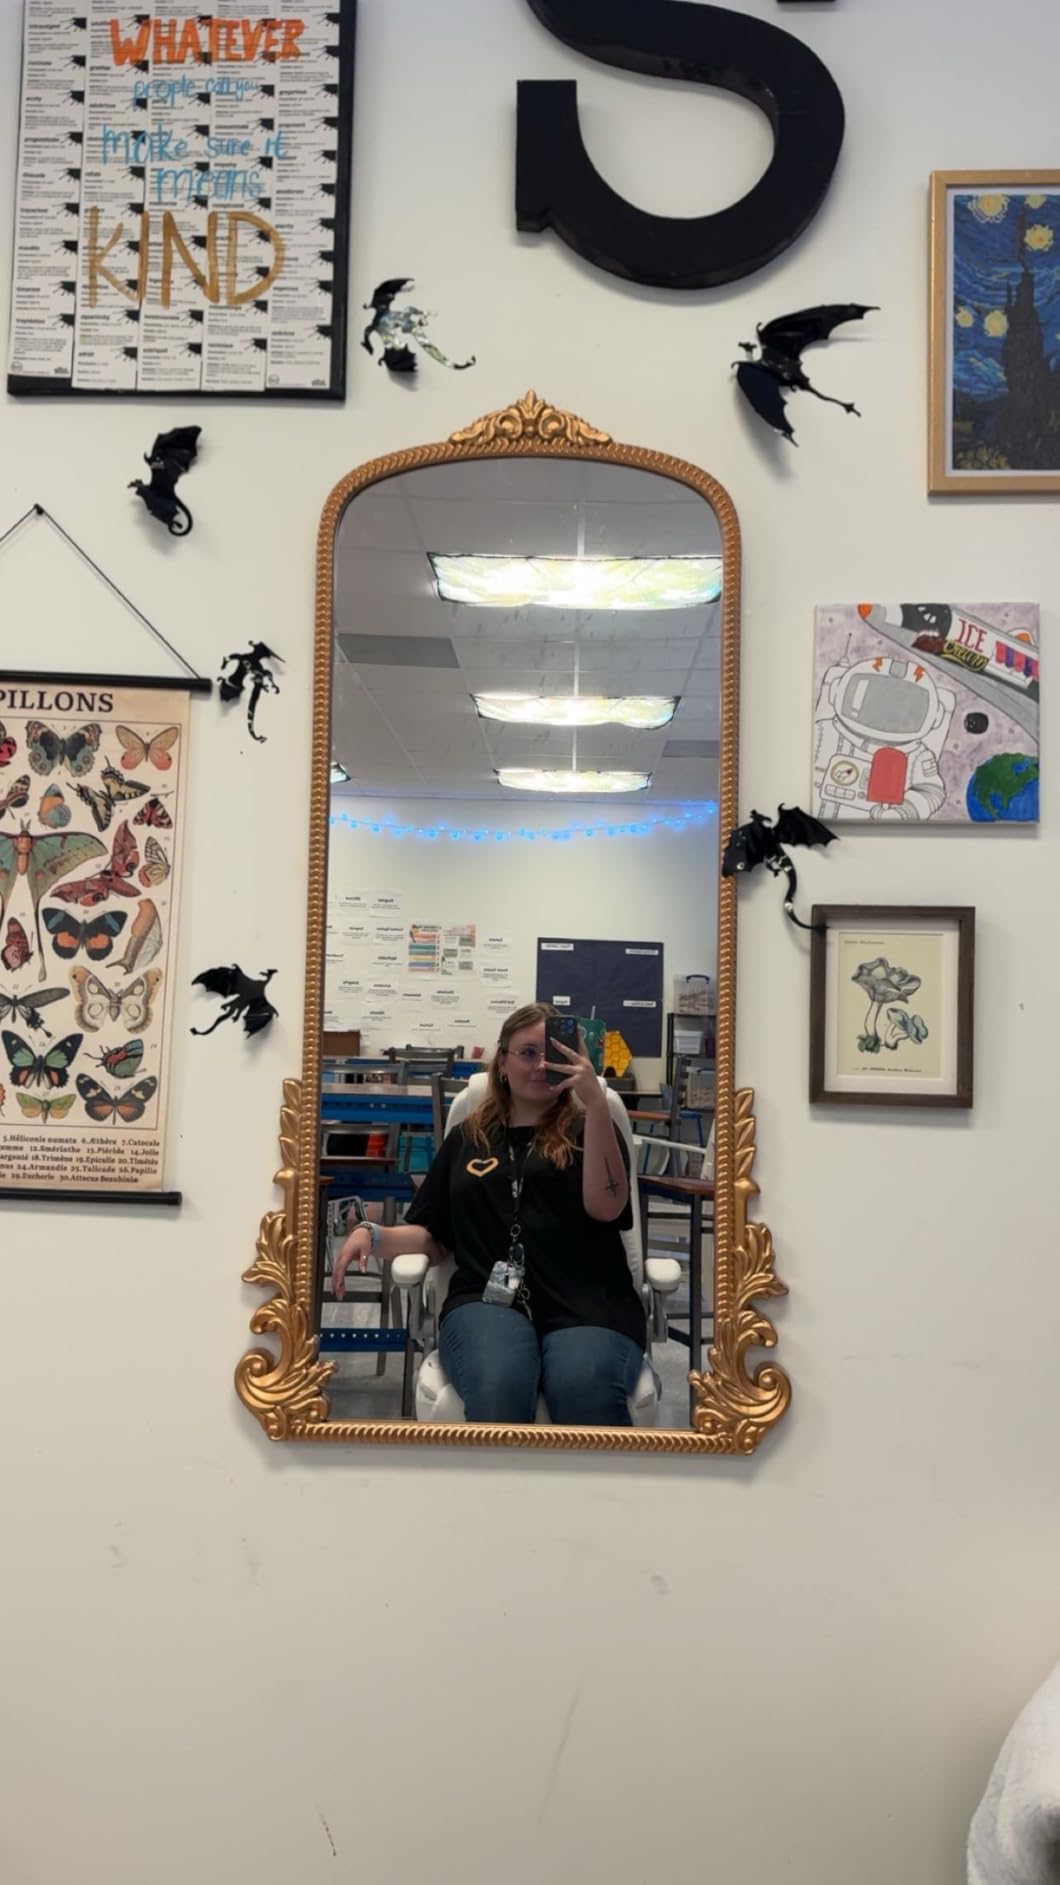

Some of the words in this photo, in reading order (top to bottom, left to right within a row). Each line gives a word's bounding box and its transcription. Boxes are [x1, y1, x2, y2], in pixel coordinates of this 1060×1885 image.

[109, 17, 305, 66] WHATEVER
[132, 75, 197, 111] people
[234, 78, 260, 99] you
[101, 122, 189, 166] make
[206, 136, 252, 158] sure
[264, 129, 291, 160] it
[154, 166, 263, 202] means
[87, 206, 286, 309] KIND
[955, 618, 987, 653] ICE
